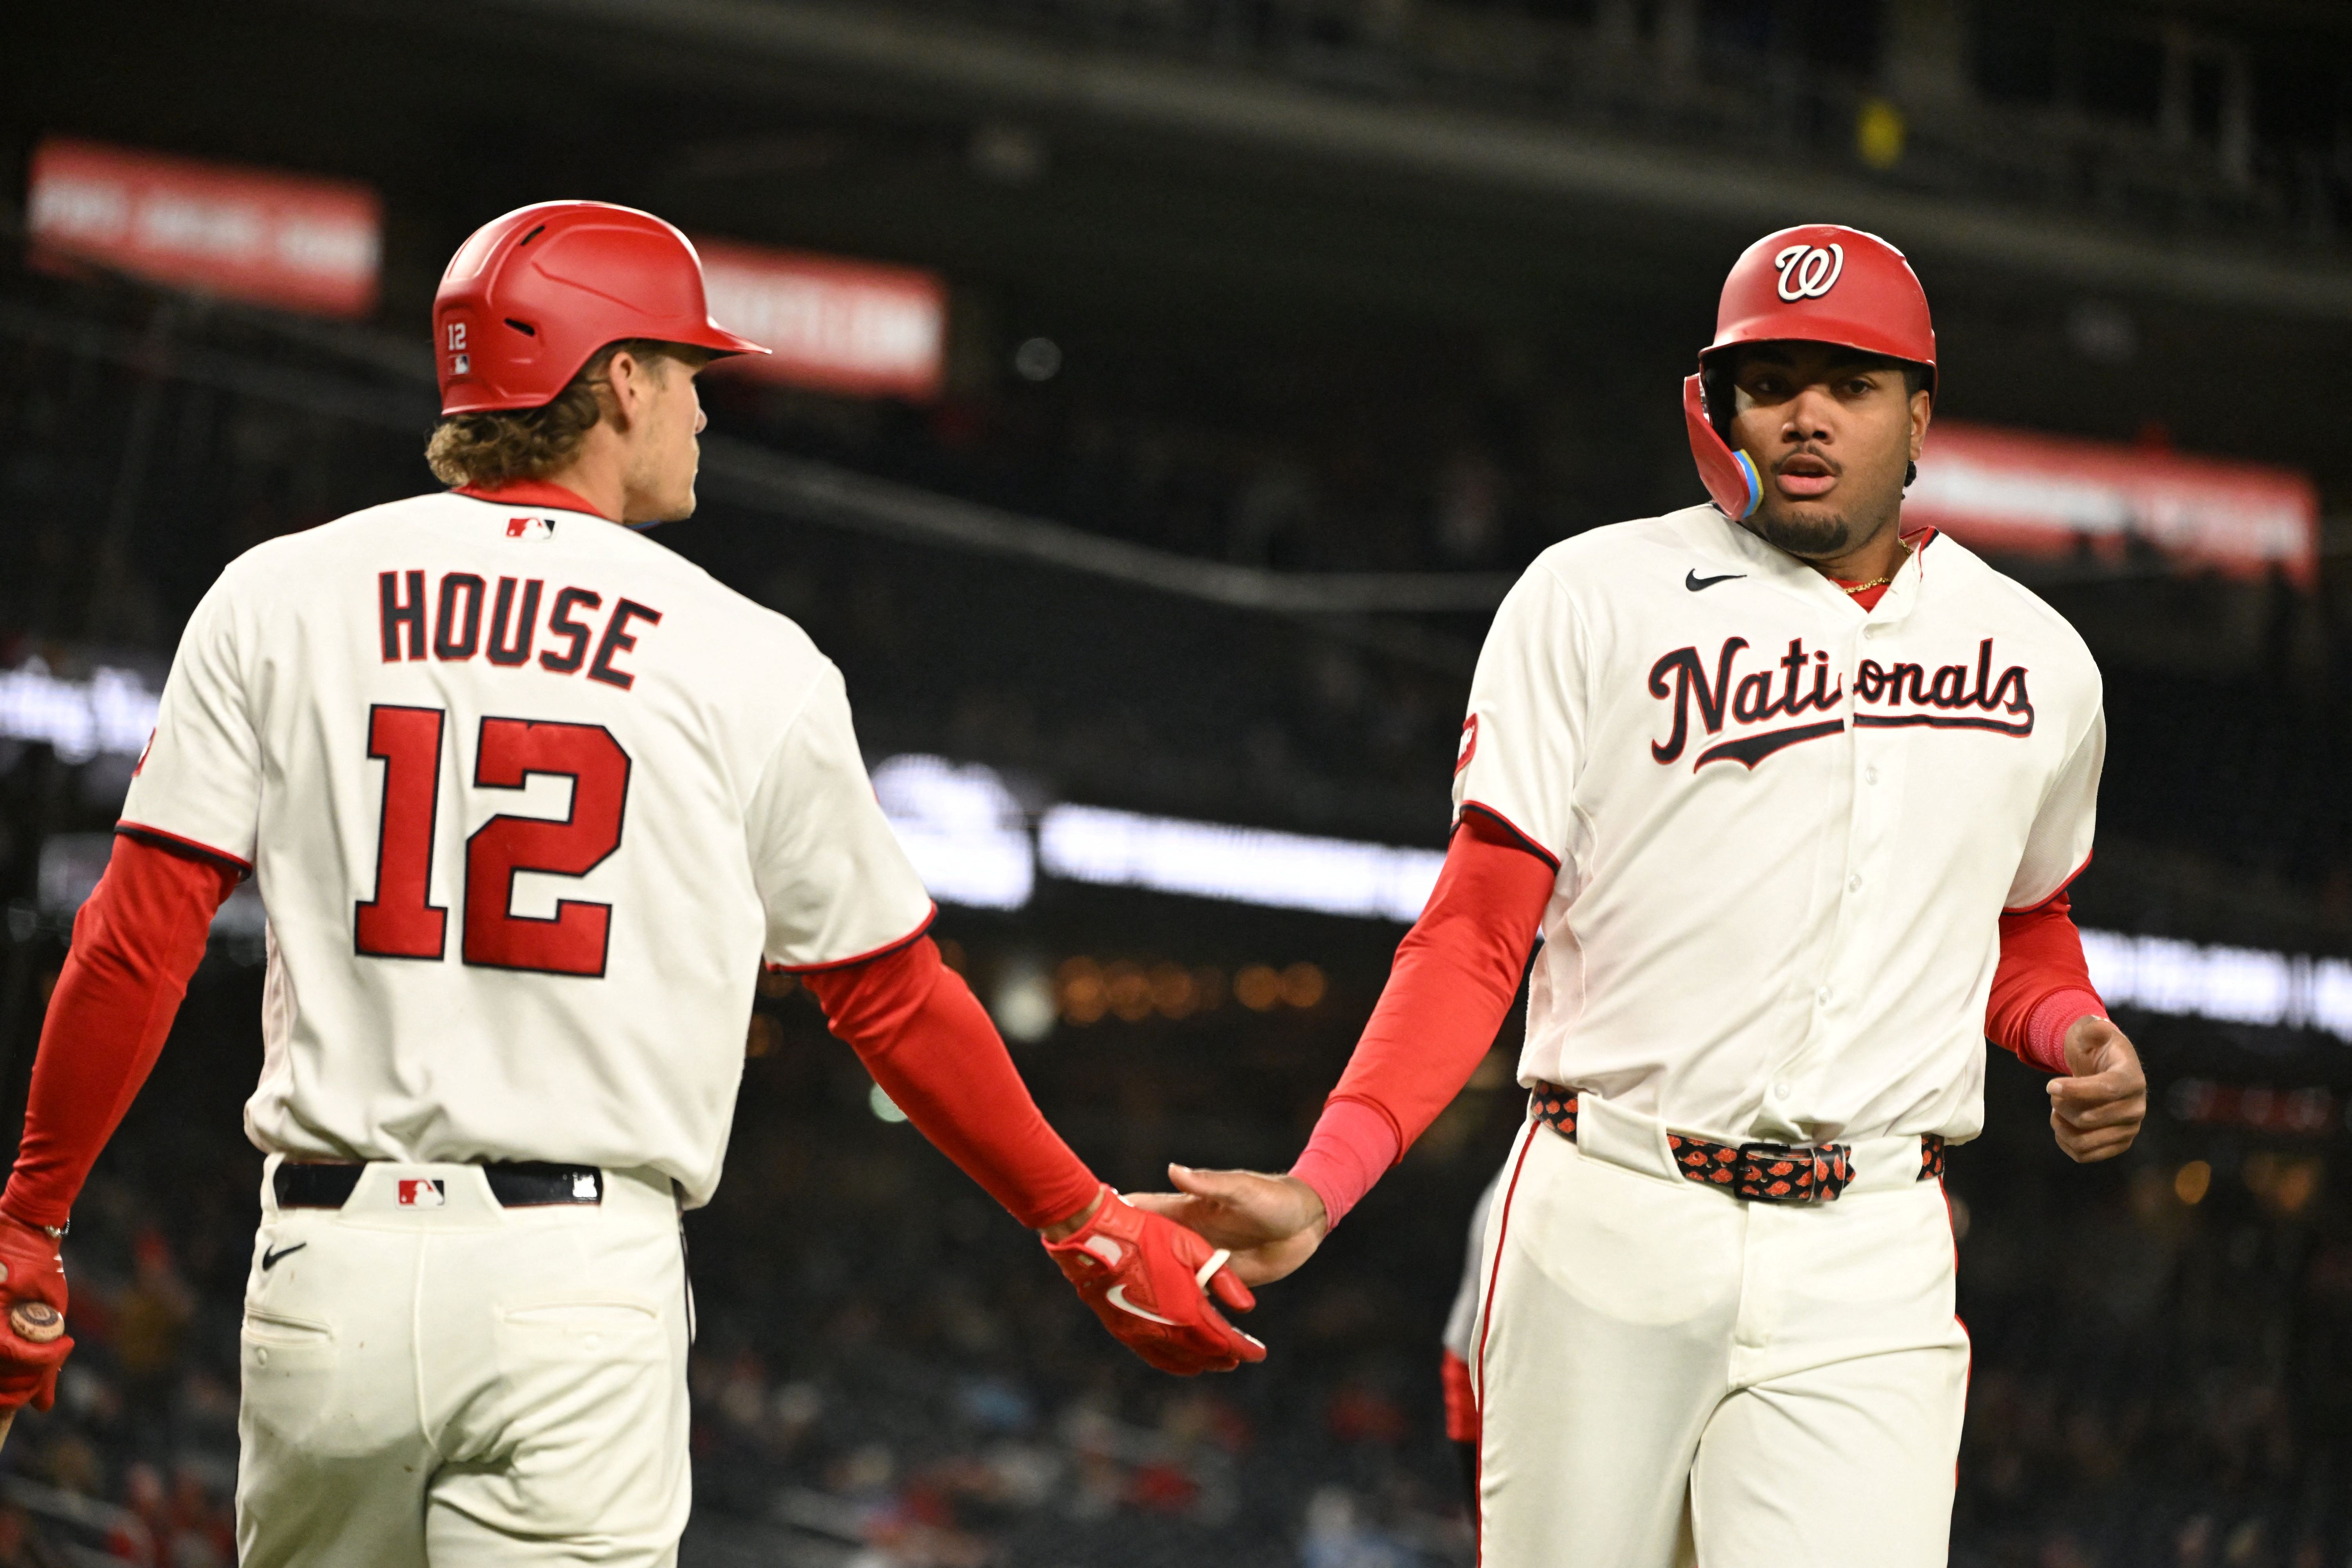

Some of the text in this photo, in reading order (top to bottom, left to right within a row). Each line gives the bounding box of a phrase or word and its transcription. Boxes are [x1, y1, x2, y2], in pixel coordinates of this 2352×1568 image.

[1775, 243, 1844, 303] W
[448, 322, 466, 351] 12
[378, 570, 663, 692] HOUSE
[1648, 636, 2034, 765] Nationals
[354, 703, 632, 979] 12
